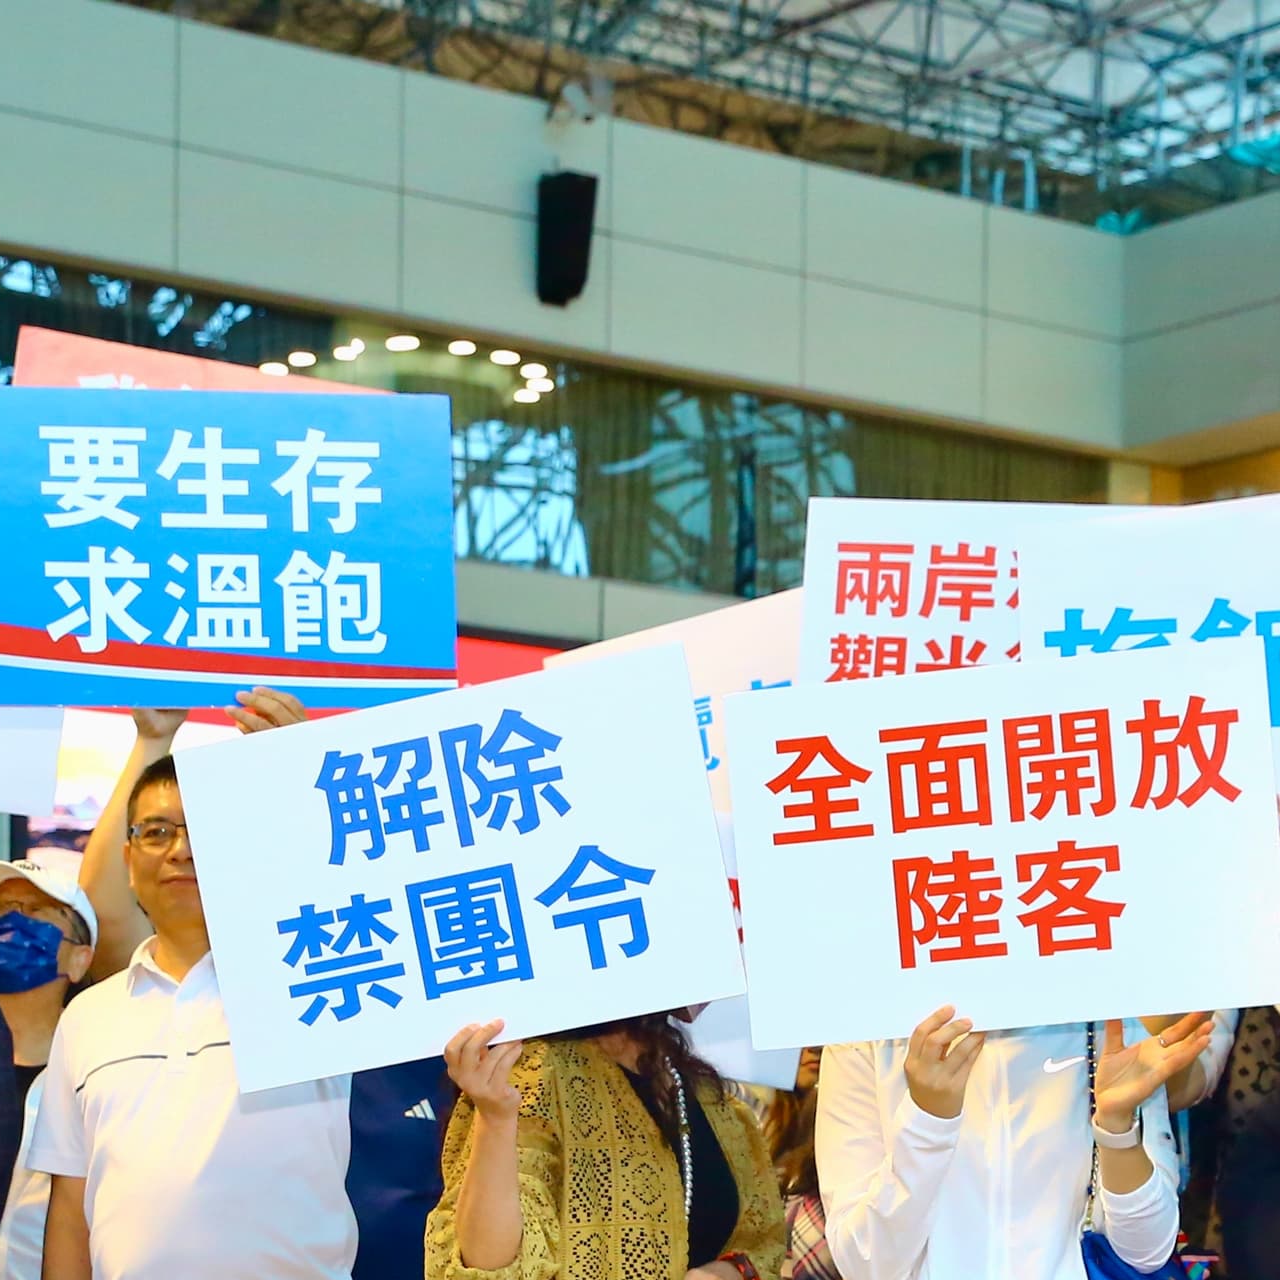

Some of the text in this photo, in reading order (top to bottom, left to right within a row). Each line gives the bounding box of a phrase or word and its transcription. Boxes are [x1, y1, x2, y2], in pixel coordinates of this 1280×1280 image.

[39, 426, 382, 534] 要生存
[44, 545, 388, 654] 求溫飽
[835, 541, 1018, 622] 兩岸
[315, 709, 571, 865] 解除
[765, 695, 1242, 845] 全面開放
[276, 845, 655, 1026] 禁團令
[892, 840, 1126, 968] 陸客
